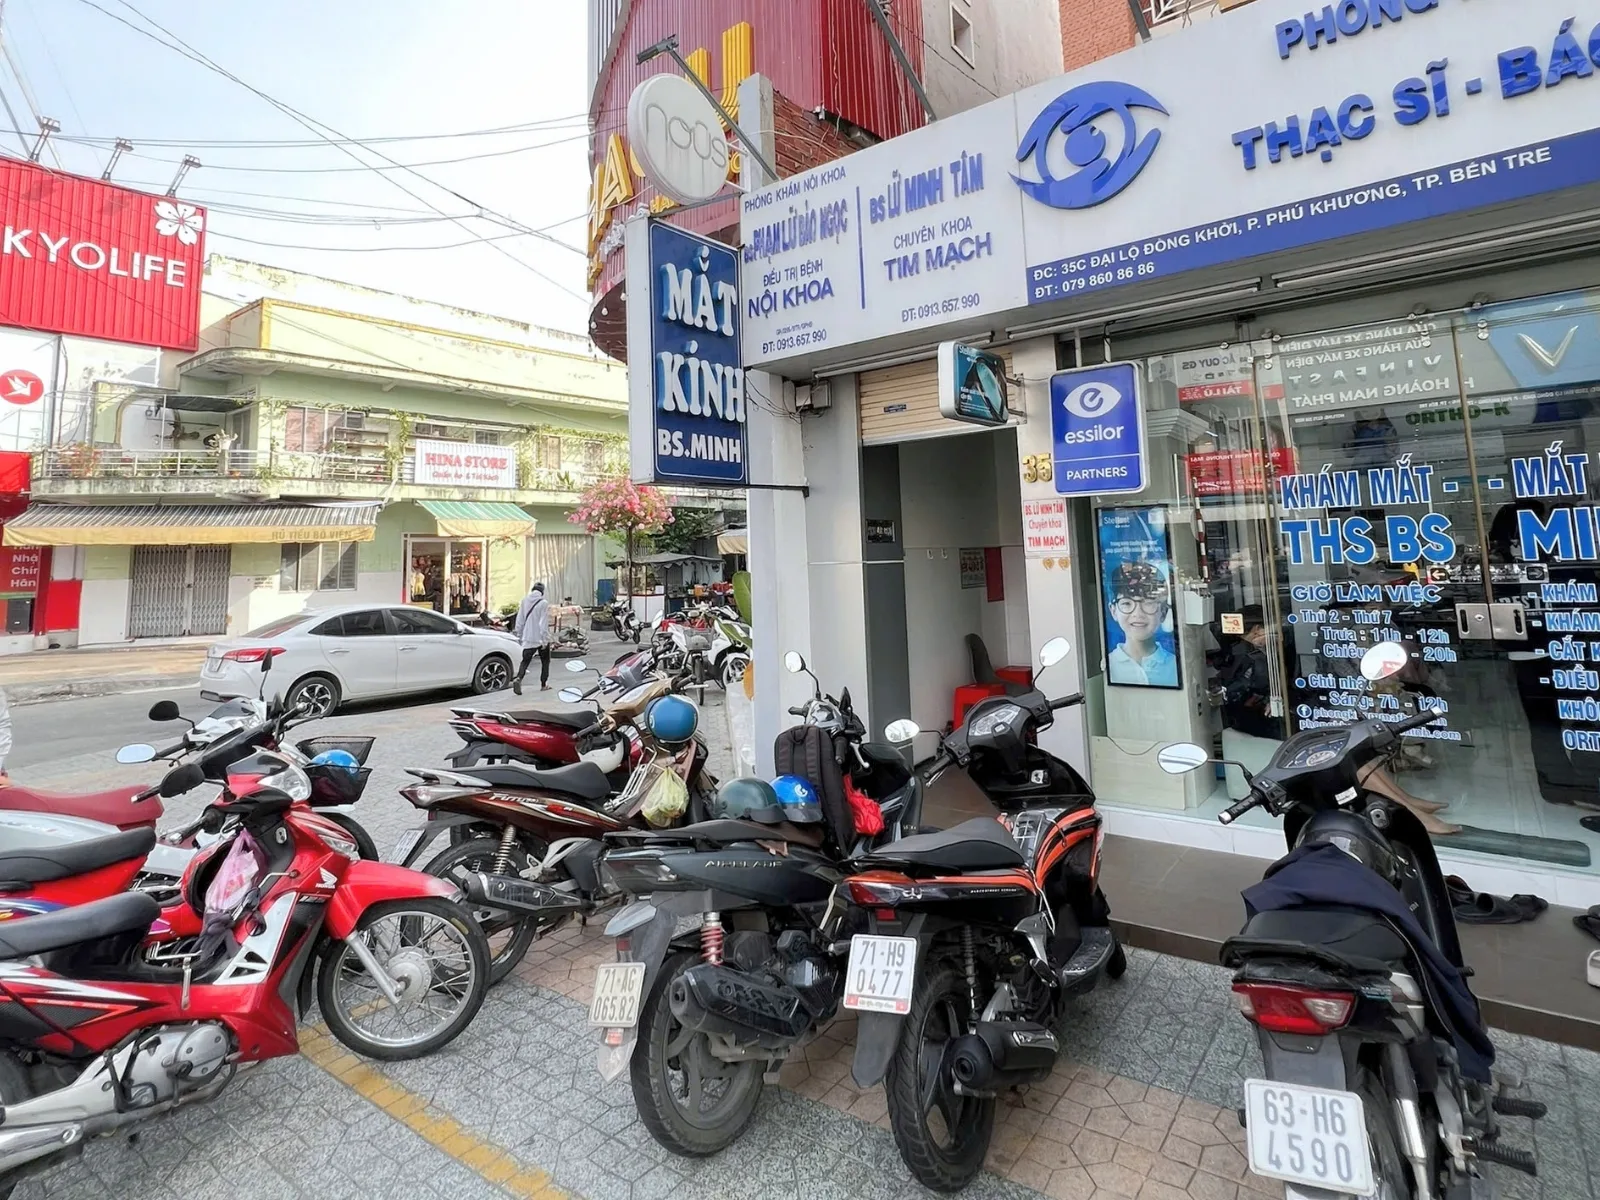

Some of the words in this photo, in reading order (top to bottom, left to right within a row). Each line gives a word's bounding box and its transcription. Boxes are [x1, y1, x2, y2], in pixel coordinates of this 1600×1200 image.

[1231, 94, 1375, 171] THẠC
[1392, 57, 1449, 126] SĨ
[744, 192, 772, 212] PHÒNG
[776, 181, 800, 202] KHÁM
[804, 174, 818, 193] NỘI
[820, 166, 846, 186] KHOA
[869, 194, 886, 225] BS
[904, 166, 944, 214] MINH
[950, 150, 984, 198] TÂM
[820, 198, 848, 244] NGỌC
[1060, 260, 1086, 276] 35C
[1090, 251, 1116, 268] ĐẠI
[1119, 244, 1140, 262] LỘ
[1247, 217, 1261, 231] P.
[1266, 204, 1304, 226] PHÚ
[1412, 174, 1444, 191] TP.
[1502, 147, 1552, 170] TRE
[894, 225, 935, 250] CHUYÊN
[941, 216, 972, 237] KHOA
[2, 226, 187, 288] KYOLIFE
[784, 266, 798, 282] TRỊ
[800, 258, 823, 278] BỆNH
[884, 252, 920, 282] TIM
[926, 232, 992, 271] MẠCH
[660, 246, 737, 337] MẮT
[1062, 278, 1086, 293] 079
[1089, 272, 1114, 287] 860
[1116, 266, 1134, 281] 86
[1138, 262, 1154, 276] 86
[748, 288, 778, 319] NỘI
[783, 278, 834, 310] KHOA
[657, 340, 746, 423] KÍNH
[658, 428, 742, 463] BS.MINH
[1064, 424, 1124, 444] essilor
[424, 452, 462, 467] HINA
[464, 456, 508, 470] STORE
[1066, 466, 1128, 480] PARTNERS
[1280, 464, 1361, 510] KHÁM
[1368, 453, 1433, 506] MẮT
[1512, 441, 1589, 498] MẮT
[1028, 518, 1048, 532] Chuyên
[1049, 518, 1062, 530] khoa
[1280, 516, 1376, 566] THS
[1386, 513, 1456, 564] BS
[1028, 536, 1041, 548] TIM
[1043, 536, 1065, 550] MẠCH
[1292, 580, 1332, 602] GIỜ
[1336, 580, 1382, 602] LÀM
[1386, 582, 1442, 608] VIỆC
[1541, 579, 1598, 602] KHÁM
[1328, 610, 1339, 624] 2
[1382, 610, 1392, 624] 7
[1370, 627, 1402, 642] 11h
[1416, 628, 1450, 644] 12h
[1549, 635, 1586, 661] CẮT
[1422, 647, 1458, 662] 20h
[1552, 664, 1599, 690] ĐIỀU
[1378, 694, 1400, 709] 7h
[856, 968, 904, 996] 0477
[593, 996, 635, 1021] 065.82
[1263, 1089, 1346, 1136] 63-H6
[1268, 1130, 1353, 1183] 4590
